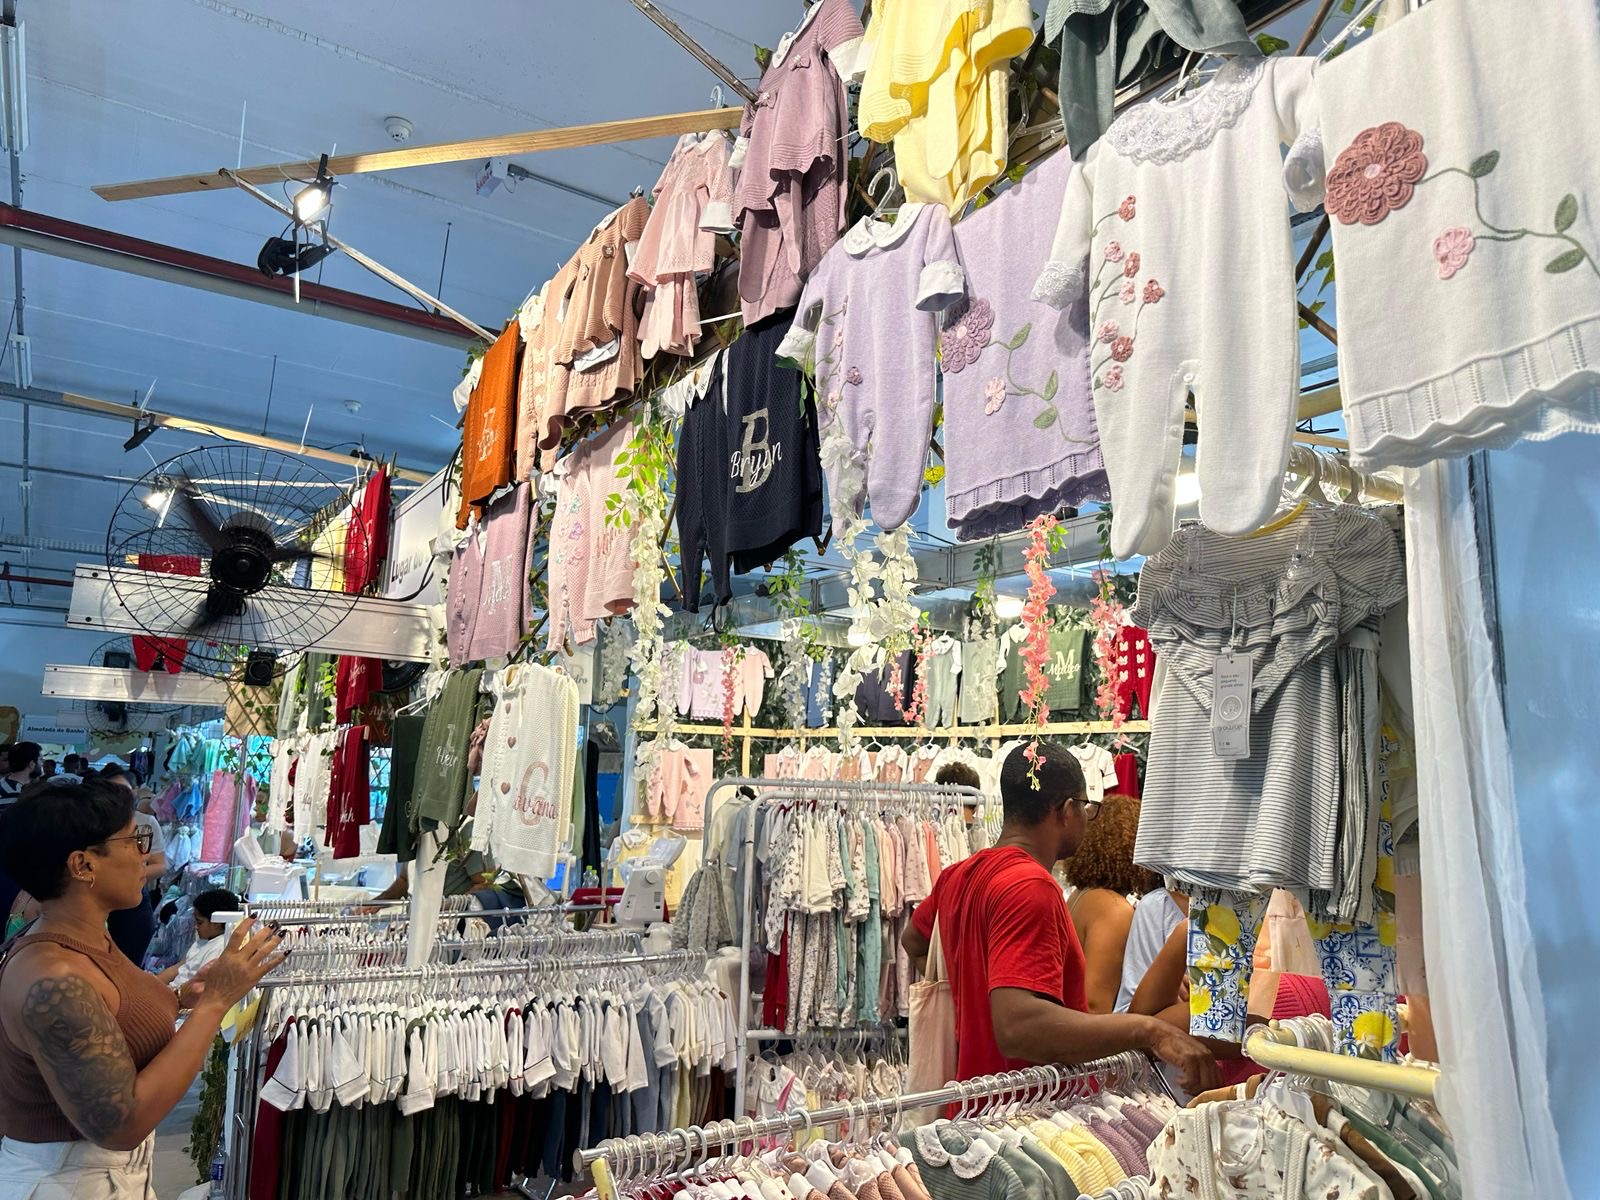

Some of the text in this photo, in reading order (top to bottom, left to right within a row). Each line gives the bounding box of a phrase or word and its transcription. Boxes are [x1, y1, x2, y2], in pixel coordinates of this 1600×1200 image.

[730, 441, 783, 487] Bryan
[736, 408, 772, 493] B
[1055, 649, 1075, 681] M
